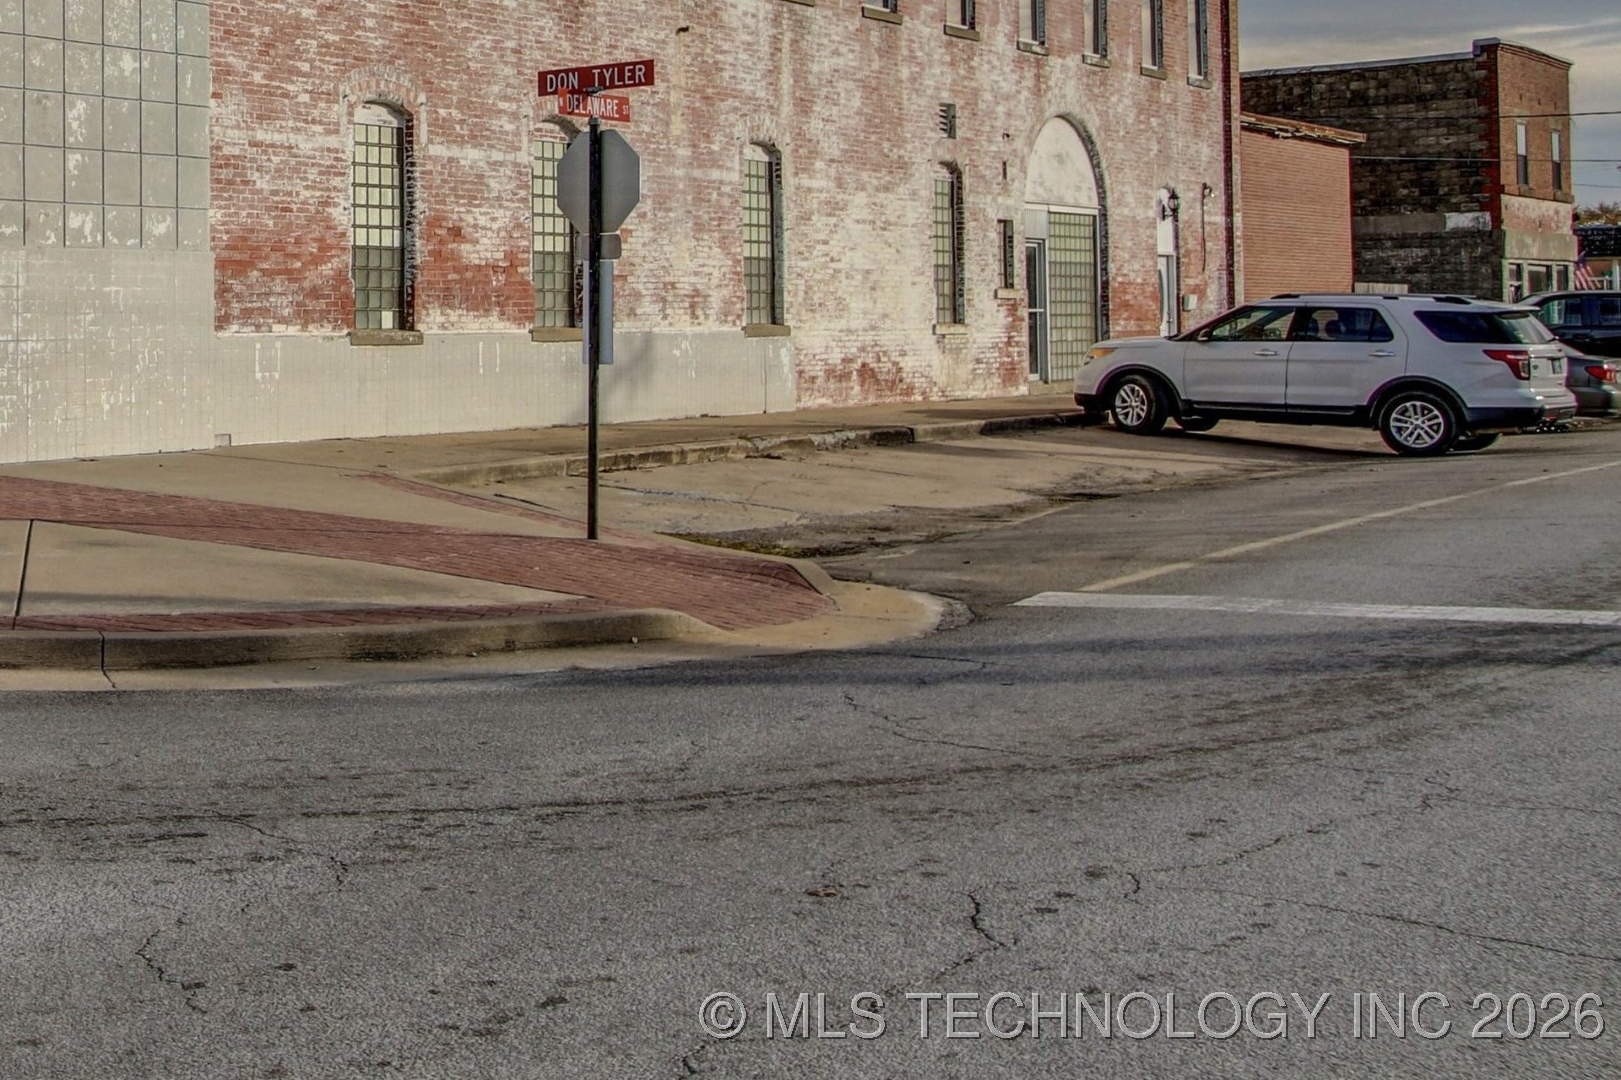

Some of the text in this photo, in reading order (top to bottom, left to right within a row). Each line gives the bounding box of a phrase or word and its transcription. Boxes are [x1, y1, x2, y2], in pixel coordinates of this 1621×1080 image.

[547, 65, 646, 93] DON TYLER
[566, 94, 619, 118] DELAWARE
[622, 105, 629, 115] ST
